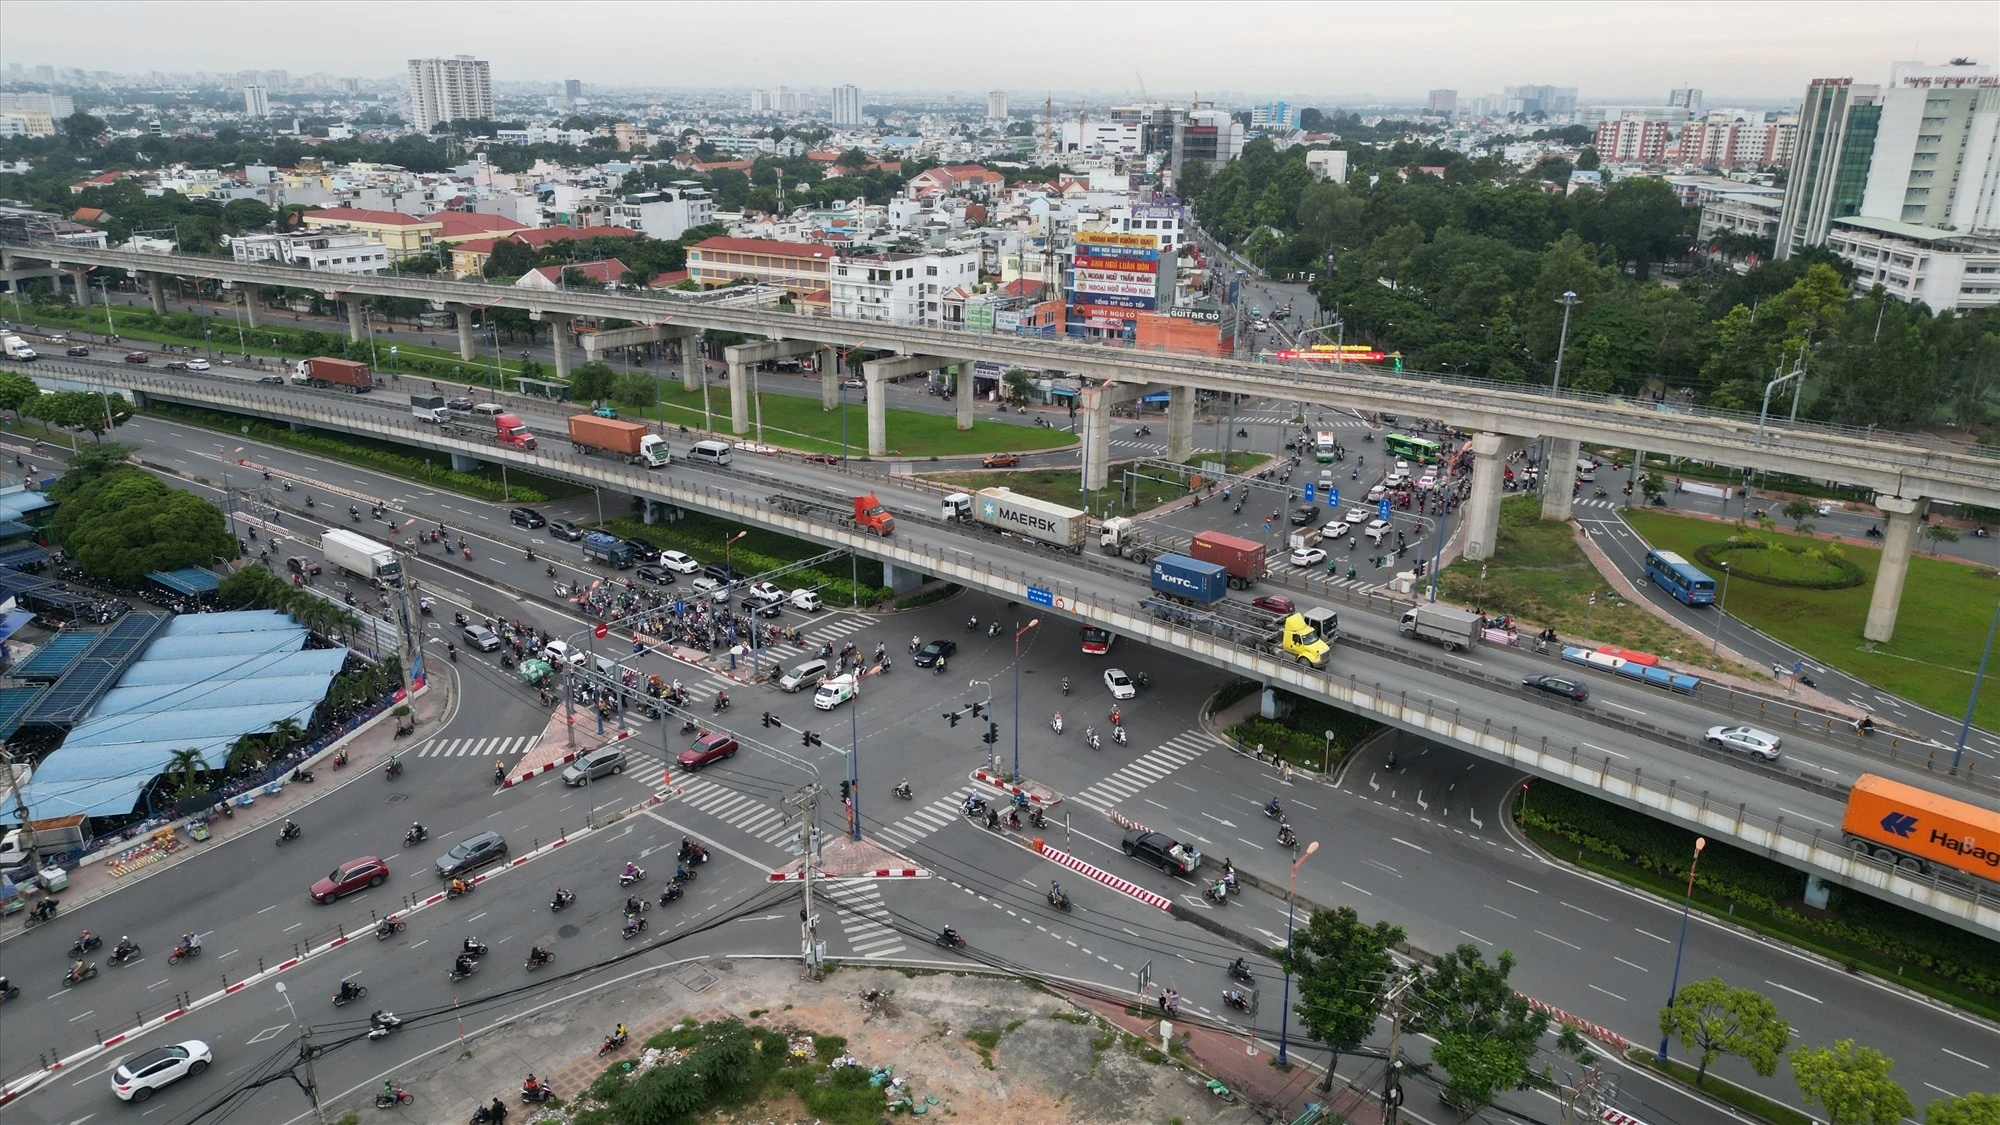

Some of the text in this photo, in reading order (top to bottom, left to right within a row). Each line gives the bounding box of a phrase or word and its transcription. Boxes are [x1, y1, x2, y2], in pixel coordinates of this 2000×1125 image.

[1170, 310, 1205, 320] GUITAR
[1000, 507, 1056, 533] MAERSK
[1162, 574, 1191, 587] KMTC
[1930, 830, 2000, 867] Hapag
